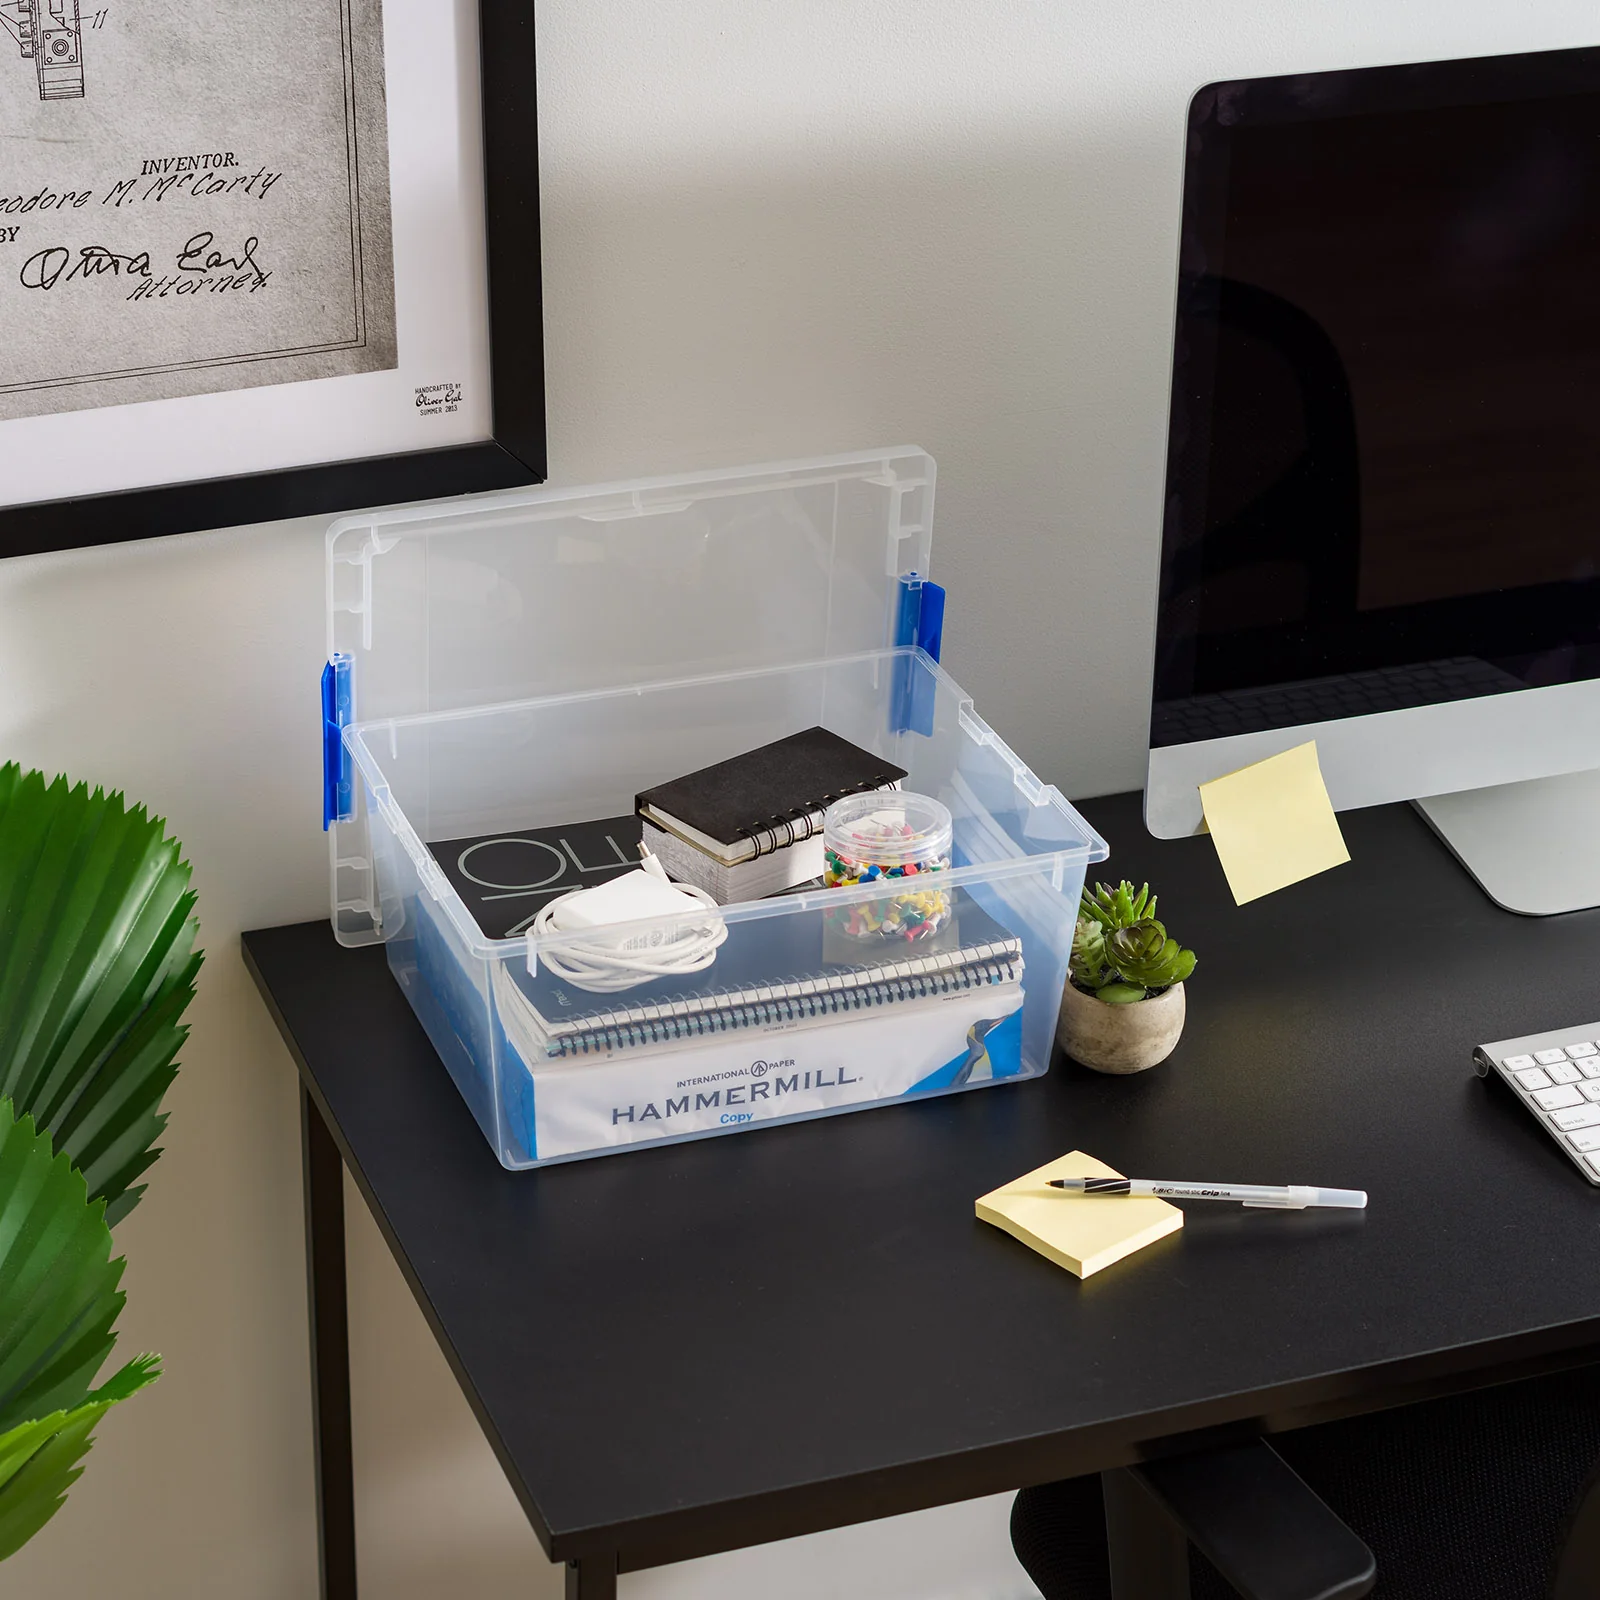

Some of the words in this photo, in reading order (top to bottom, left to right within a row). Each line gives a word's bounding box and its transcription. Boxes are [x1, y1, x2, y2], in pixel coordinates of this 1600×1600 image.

[141, 152, 239, 175] INVENTOR.
[102, 179, 138, 207] M.
[415, 383, 453, 394] HANDCRAFTED
[416, 393, 443, 407] Oliver
[420, 407, 442, 416] SUMMER
[676, 1069, 750, 1088] INTERNATIONAL
[768, 1059, 796, 1070] PAPER
[612, 1066, 857, 1126] HAMMERMILL
[720, 1111, 754, 1124] Copy
